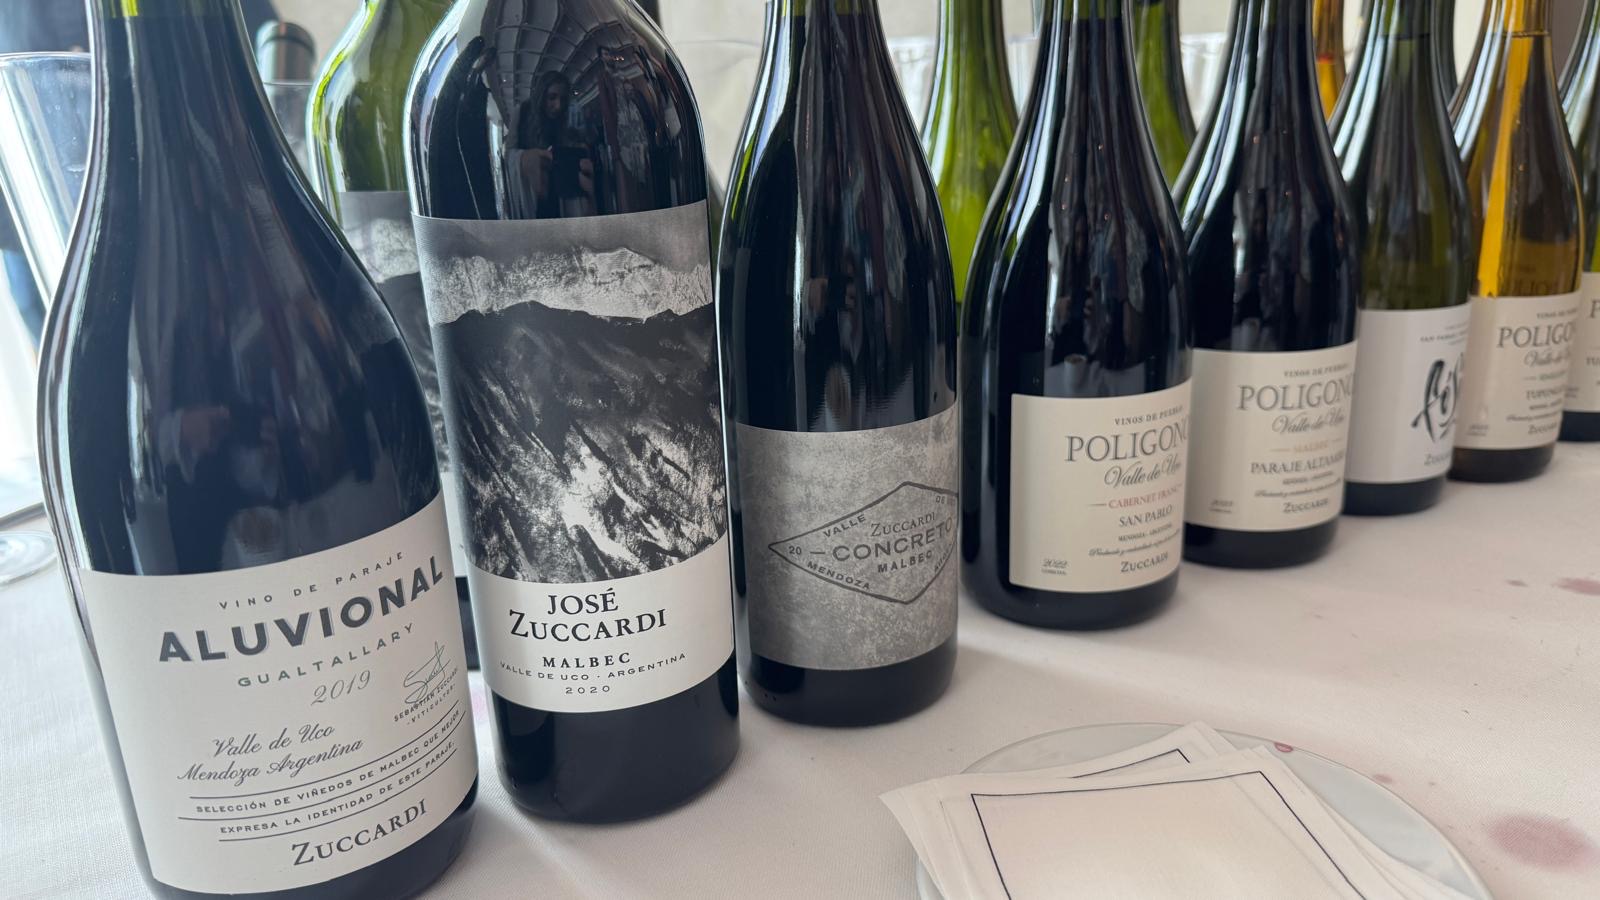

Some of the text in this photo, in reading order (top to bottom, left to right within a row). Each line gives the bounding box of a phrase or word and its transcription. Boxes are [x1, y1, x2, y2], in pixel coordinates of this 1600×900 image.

[1114, 415, 1143, 426] VINOS
[1145, 412, 1157, 422] DE
[1104, 460, 1146, 488] Valle
[1147, 463, 1160, 482] de
[1251, 459, 1302, 474] PARAJE
[1108, 492, 1156, 509] CABERNET
[823, 513, 866, 538] VALLE
[870, 511, 935, 537] ZUCCARDI
[1119, 504, 1173, 528] SAN PABLO
[788, 545, 802, 555] 20
[832, 516, 953, 561] CONCRETO
[807, 560, 870, 590] MENDOZA
[877, 549, 933, 573] MALBEC
[219, 551, 404, 609] VINO DE PARAJE
[158, 555, 444, 663] ALUVIONAL
[547, 587, 619, 615] JOSÉ
[509, 608, 667, 642] ZUCCARDI
[238, 622, 414, 688] GUALTALLARY
[500, 660, 532, 677] VALLE
[537, 672, 554, 680] DE
[607, 652, 686, 679] ARGENTINA
[542, 652, 631, 669] MALBEC
[310, 669, 372, 706] 2019
[565, 685, 611, 695] 2020
[212, 723, 335, 758] Valle de Uco
[176, 738, 364, 787] Mendoza Argentina
[196, 709, 460, 813] SELECCIÓN DE VIÑEDOS DE MALBEC QUE MEJOR
[220, 821, 278, 834] EXPRESA
[285, 817, 301, 827] LA
[307, 793, 373, 821] IDENTIDAD
[379, 783, 393, 795] DE
[398, 767, 421, 785] ESTE
[291, 798, 427, 866] ZUCCARDI
